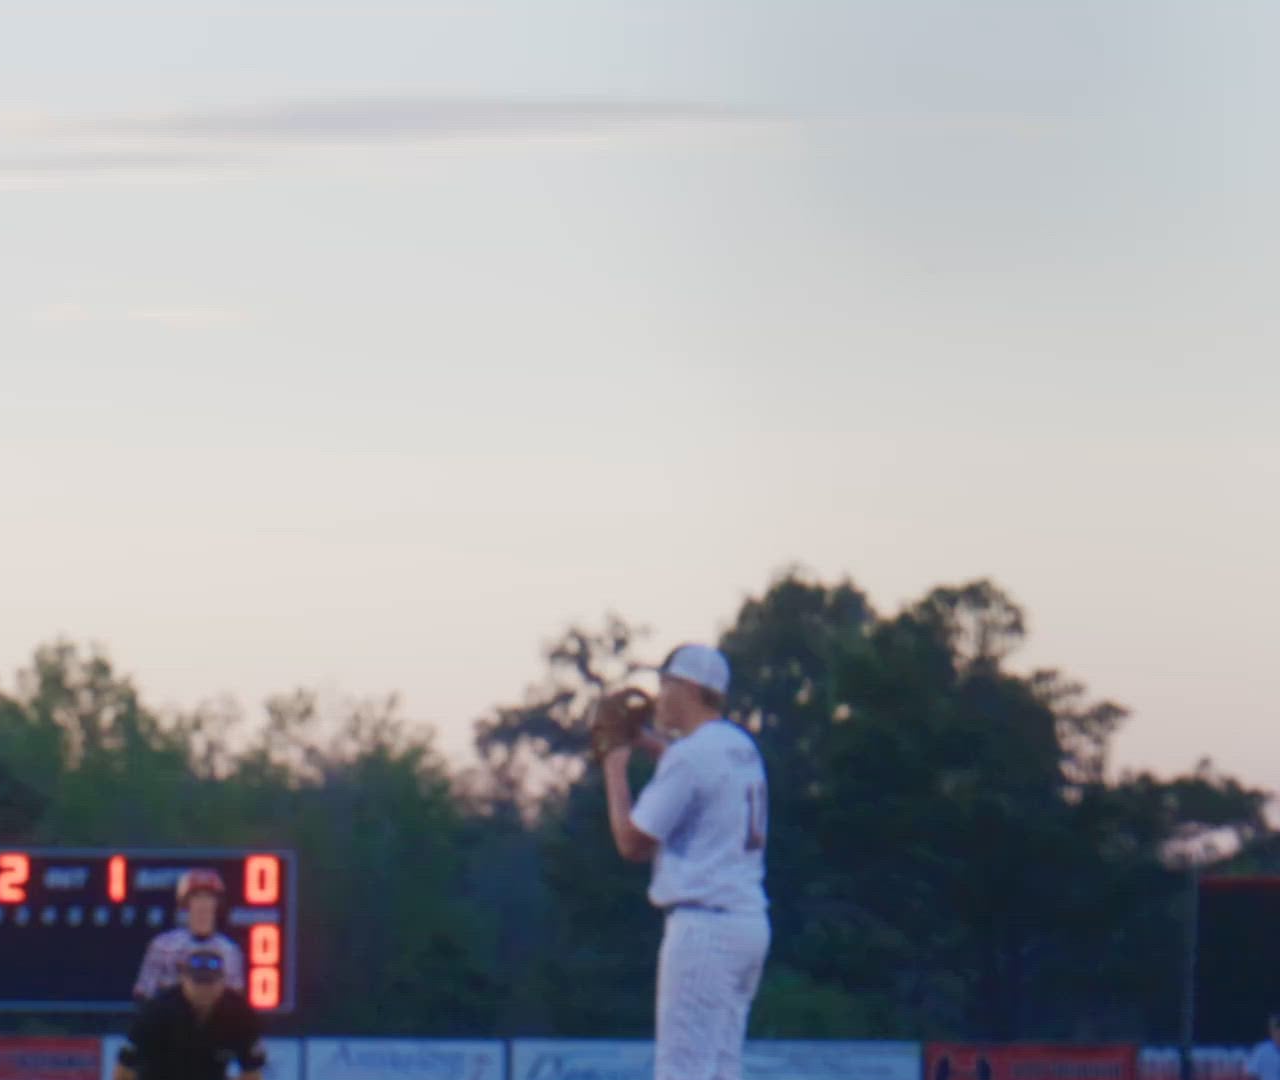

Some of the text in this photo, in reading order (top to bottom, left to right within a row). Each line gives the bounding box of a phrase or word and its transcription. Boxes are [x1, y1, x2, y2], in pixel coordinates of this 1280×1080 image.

[107, 853, 128, 903] 1
[244, 854, 281, 906] 0
[249, 923, 280, 966] 0
[248, 967, 281, 1010] 0
